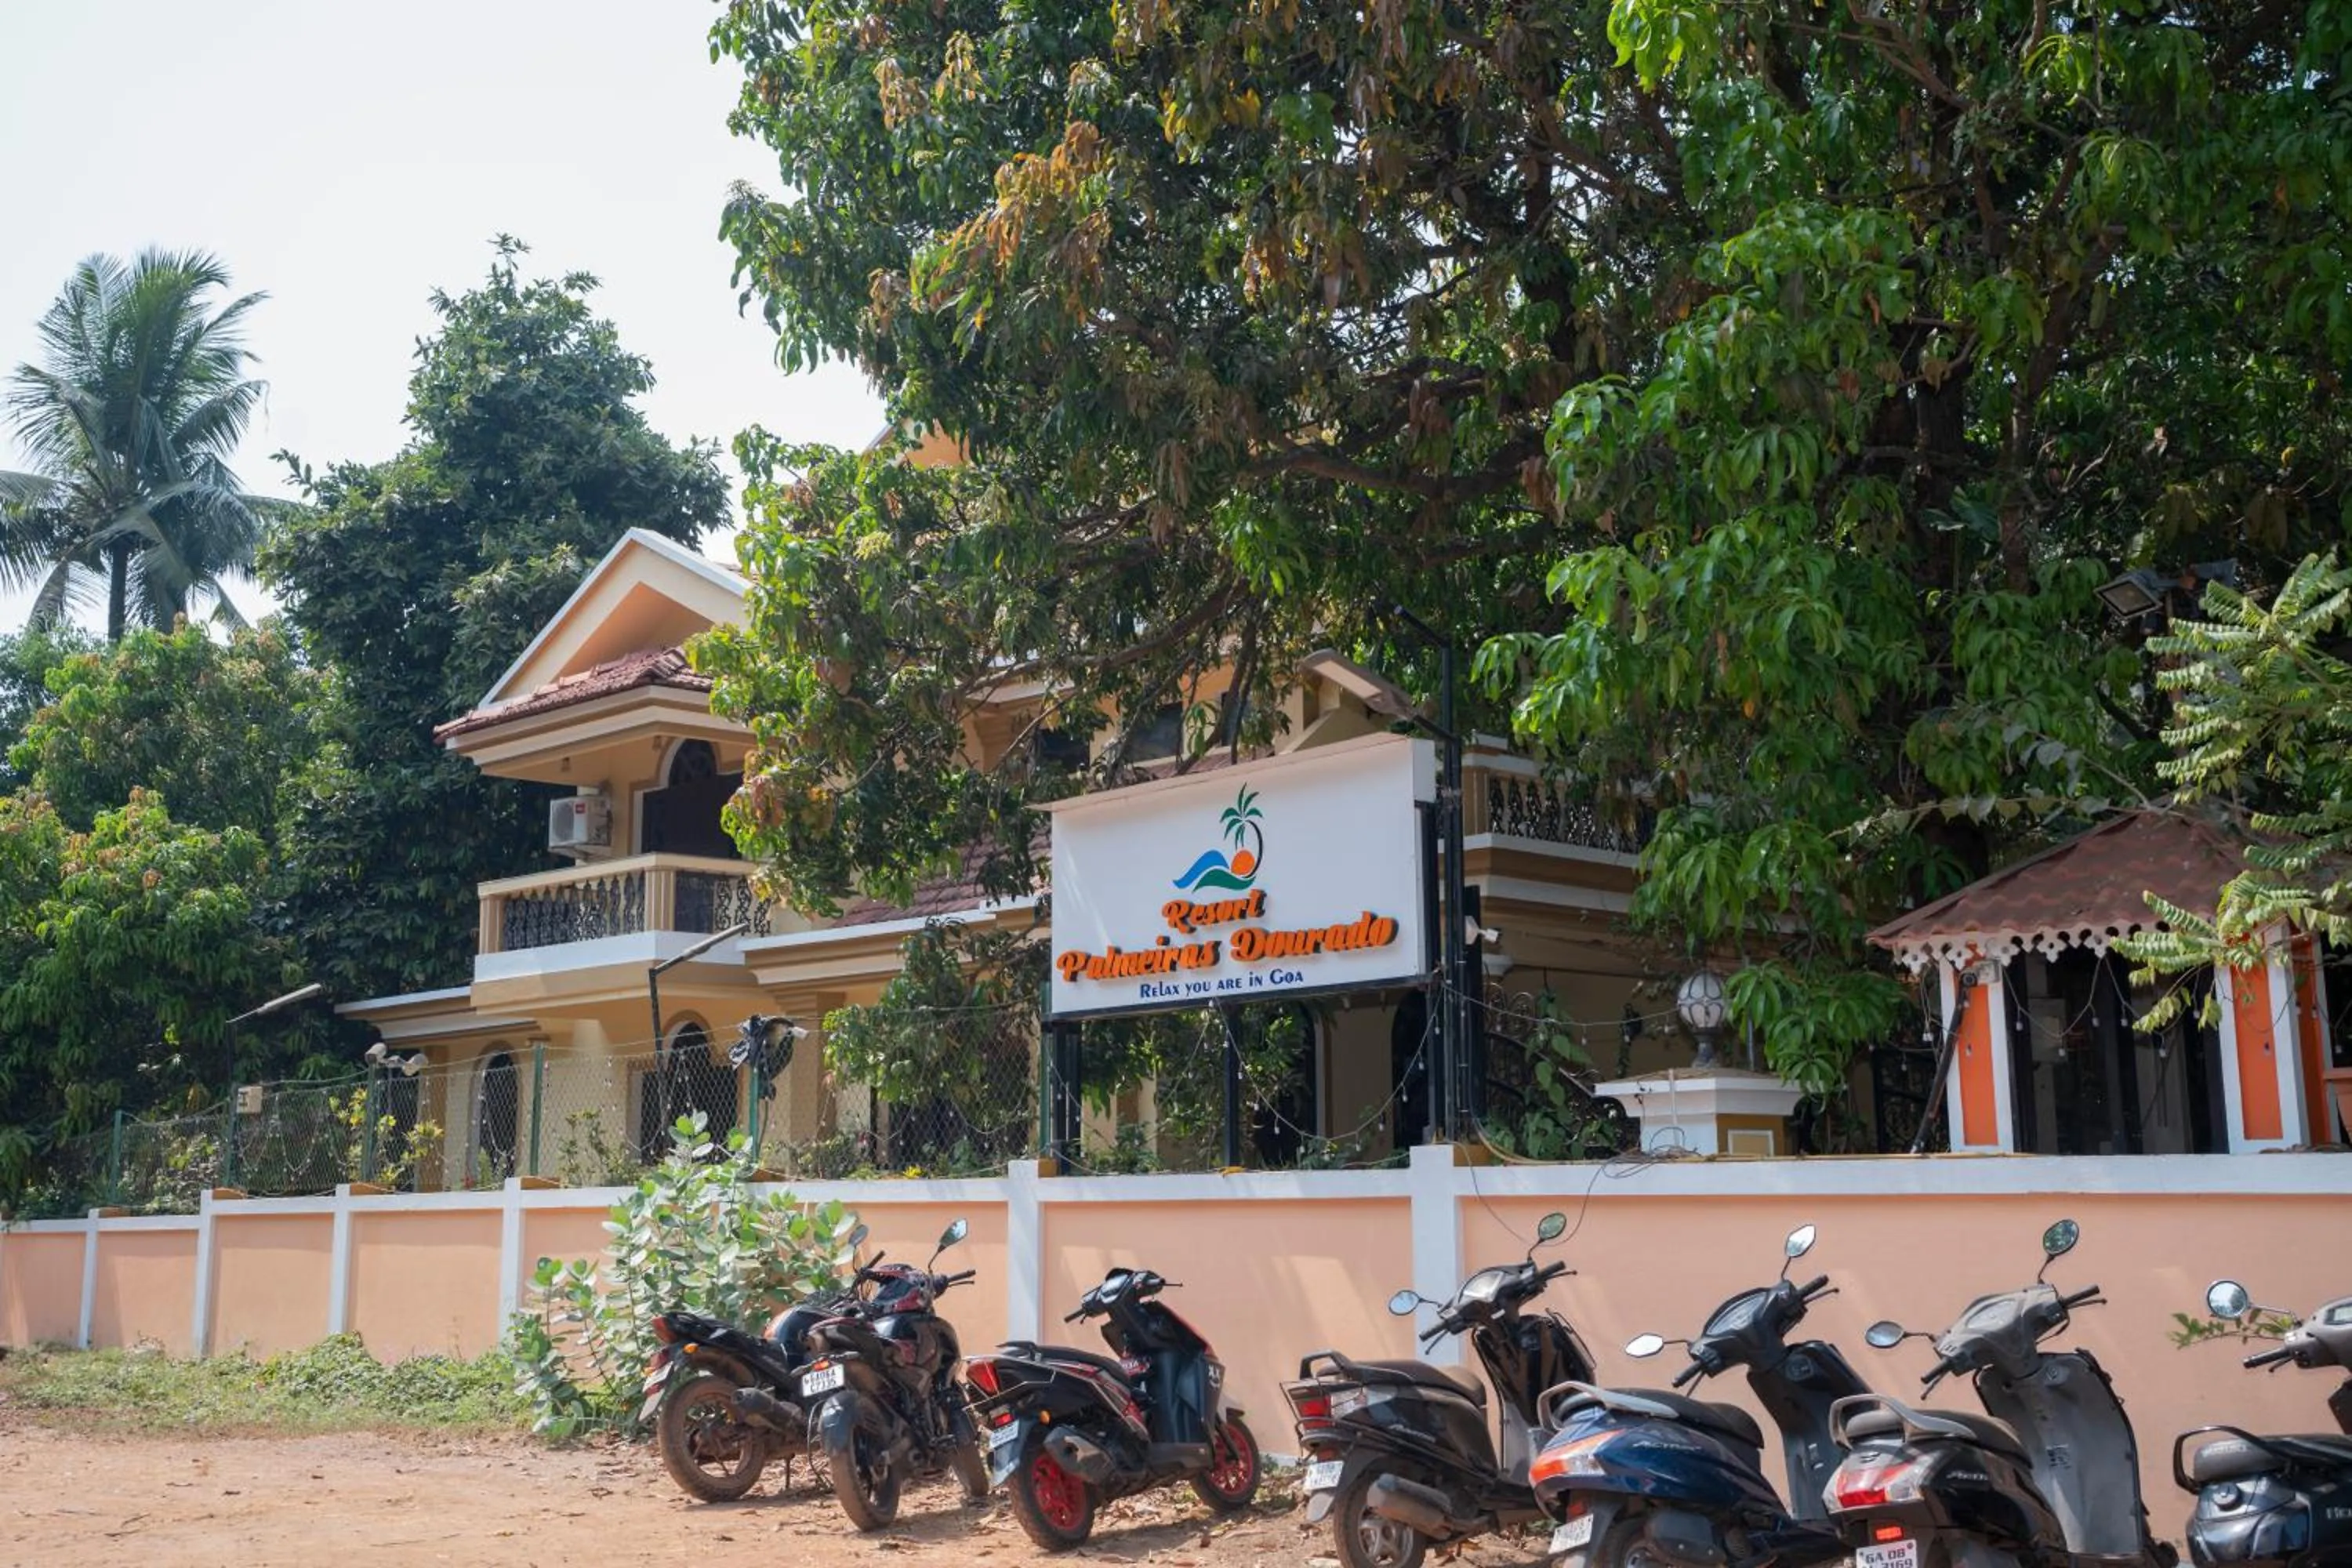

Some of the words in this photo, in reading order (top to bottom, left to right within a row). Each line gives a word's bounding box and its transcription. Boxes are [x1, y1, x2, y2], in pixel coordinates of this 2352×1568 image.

[1161, 888, 1267, 934] Resort
[1056, 935, 1221, 982] Palmeiras
[1230, 910, 1399, 961] Dourado
